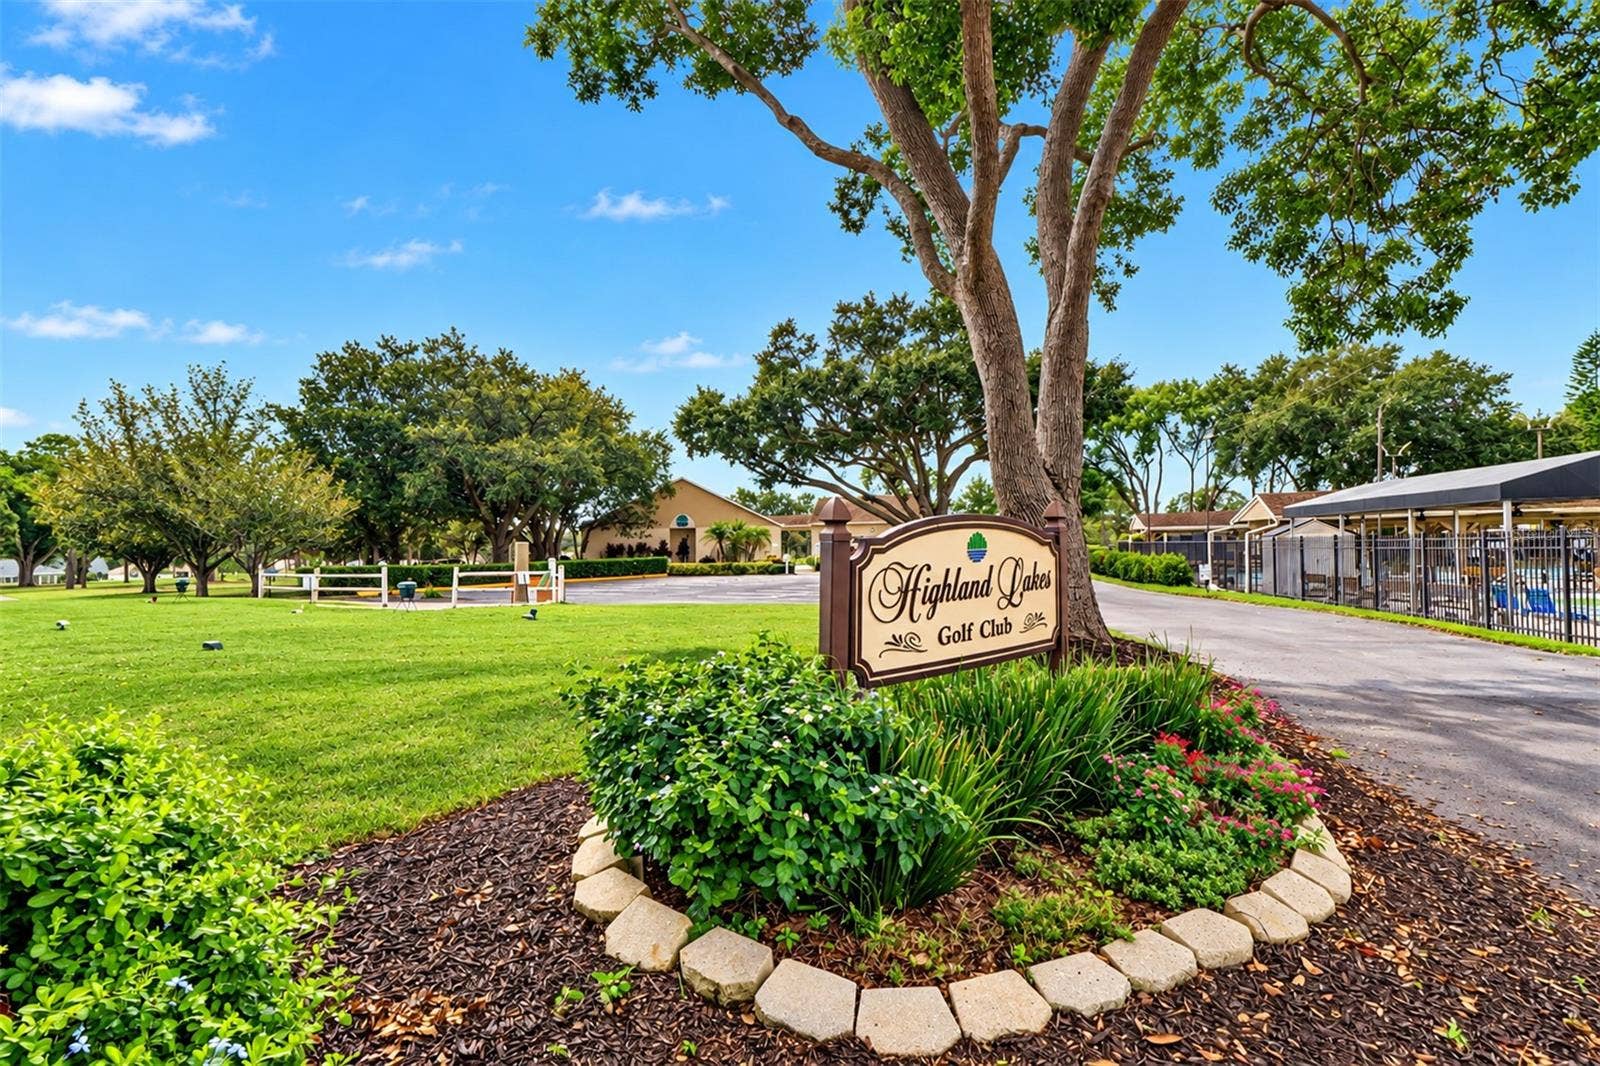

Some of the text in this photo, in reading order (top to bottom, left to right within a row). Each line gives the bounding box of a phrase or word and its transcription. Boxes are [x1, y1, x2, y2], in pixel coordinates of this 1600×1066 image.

[868, 556, 1051, 624] Highland Lakes
[937, 616, 1013, 646] Golf Club
